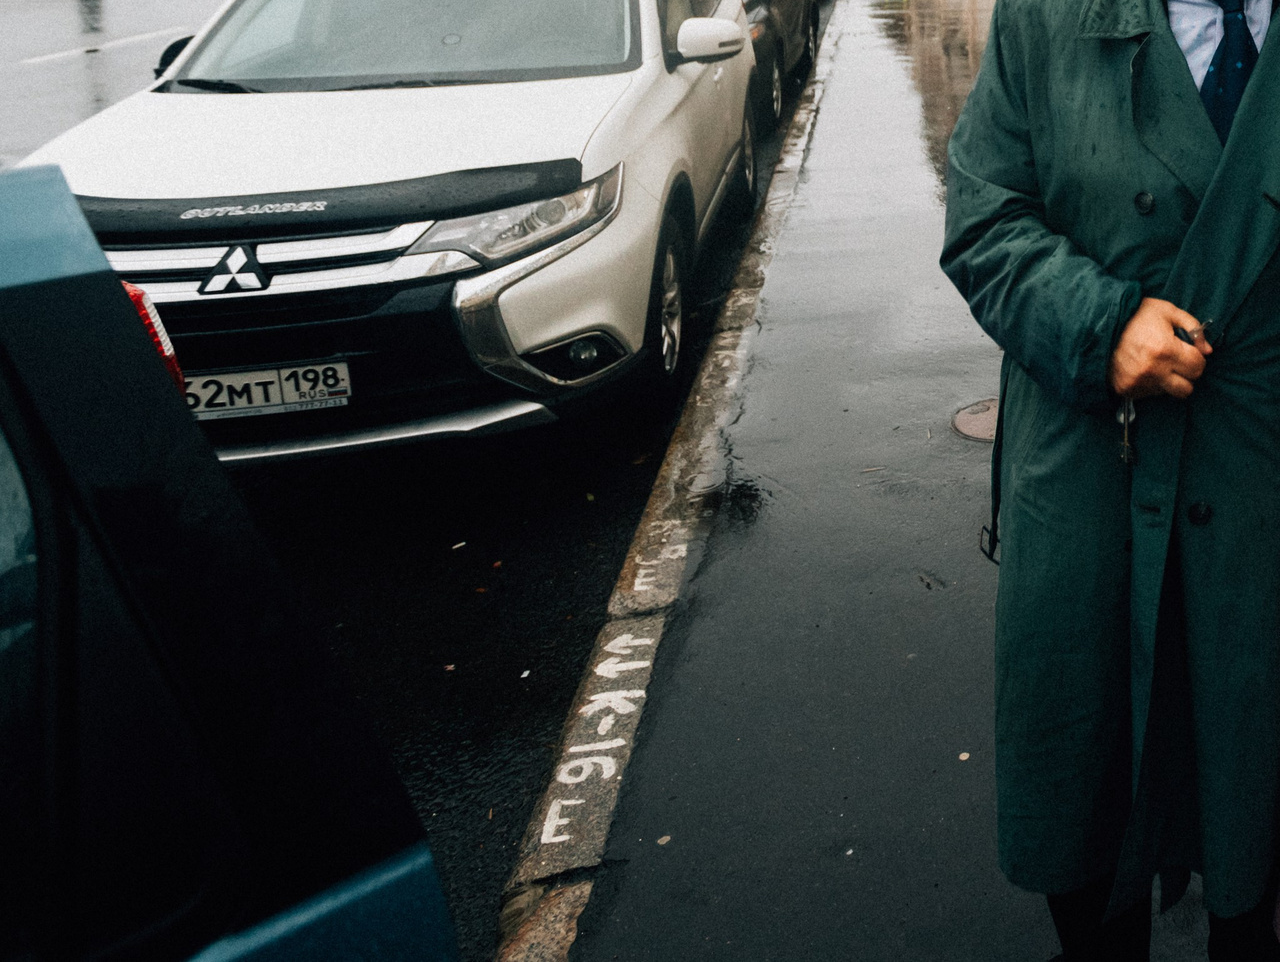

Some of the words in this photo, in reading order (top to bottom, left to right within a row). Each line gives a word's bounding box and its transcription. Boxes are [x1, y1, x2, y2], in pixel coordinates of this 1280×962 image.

[180, 201, 327, 219] OUTLANDER
[284, 367, 341, 392] 198
[299, 389, 327, 400] RUS
